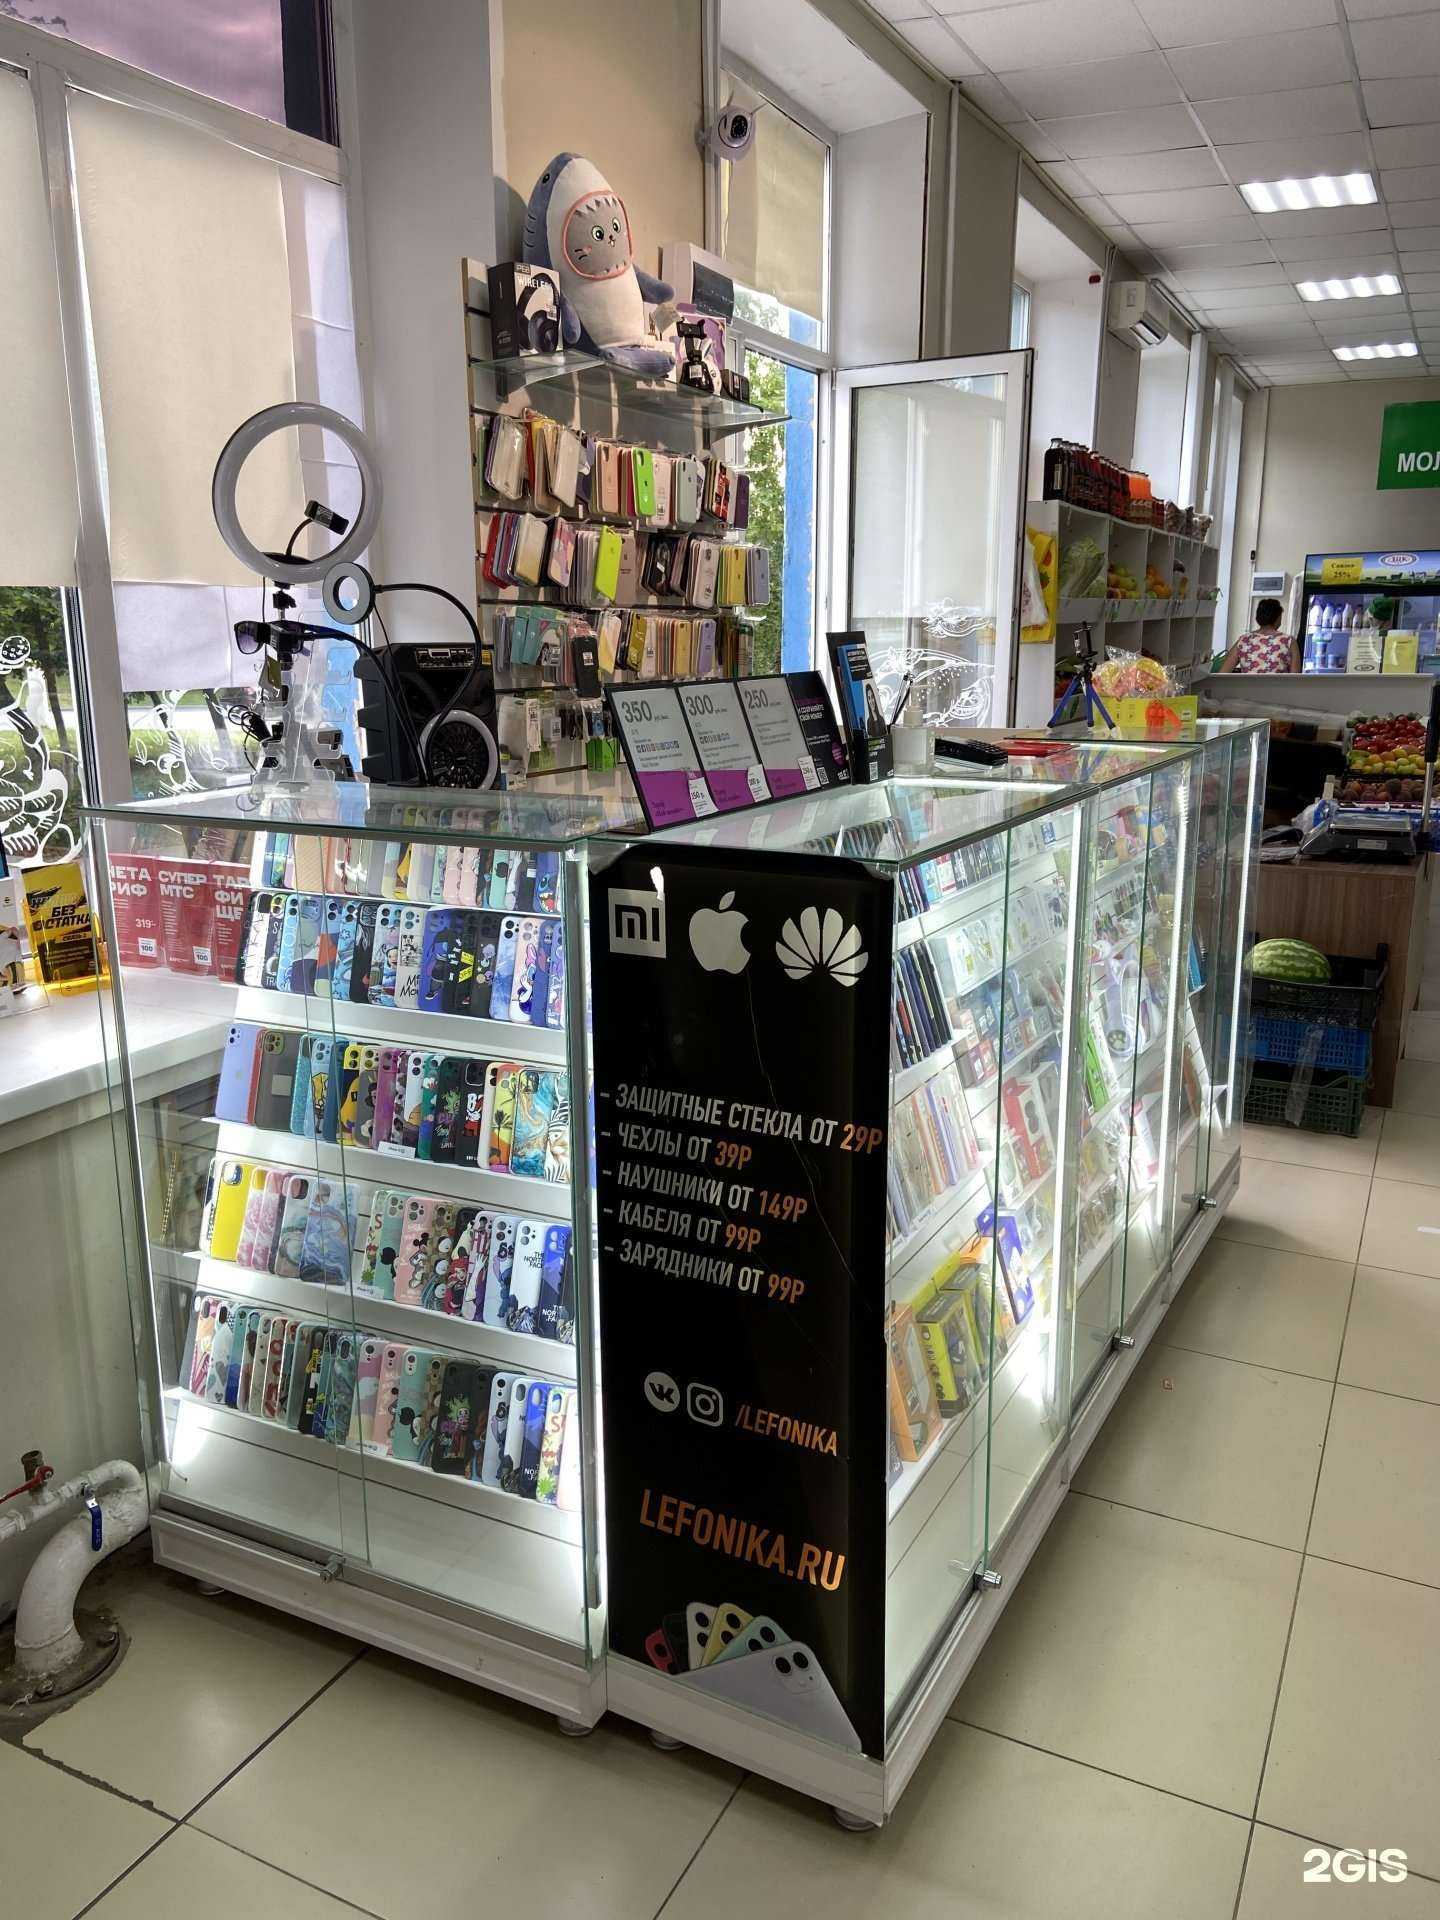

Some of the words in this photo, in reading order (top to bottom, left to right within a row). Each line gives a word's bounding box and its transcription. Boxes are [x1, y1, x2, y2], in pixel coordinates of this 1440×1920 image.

[685, 694, 713, 716] 300
[744, 688, 768, 709] 250
[622, 700, 652, 723] 350
[158, 870, 207, 885] СУПЕР
[160, 884, 194, 899] МТС
[215, 890, 243, 905] ФИ
[52, 904, 75, 918] БЕЗ
[216, 905, 243, 922] ЩЕ
[615, 1083, 724, 1126] ЗАЩИТНЫЕ
[728, 1102, 803, 1141] СТЕКЛА
[809, 1117, 838, 1146] ОТ
[840, 1123, 884, 1154] 29Р
[618, 1121, 682, 1157] ЧЕХЛЫ
[687, 1136, 712, 1163] ОТ
[714, 1141, 752, 1170] 39Р
[617, 1161, 724, 1206] НАУШНИКИ
[727, 1184, 754, 1212] ОТ
[759, 1190, 808, 1222] 149Р
[618, 1199, 691, 1238] КАБЕЛЯ
[696, 1217, 722, 1244] ОТ
[724, 1223, 761, 1252] 99Р
[619, 1238, 733, 1287] ЗАРЯДНИКИ
[738, 1266, 764, 1294] ОТ
[768, 1273, 805, 1303] 99Р
[734, 1404, 837, 1457] /LEFONIKA
[639, 1488, 846, 1591] LEFONIKA.RU
